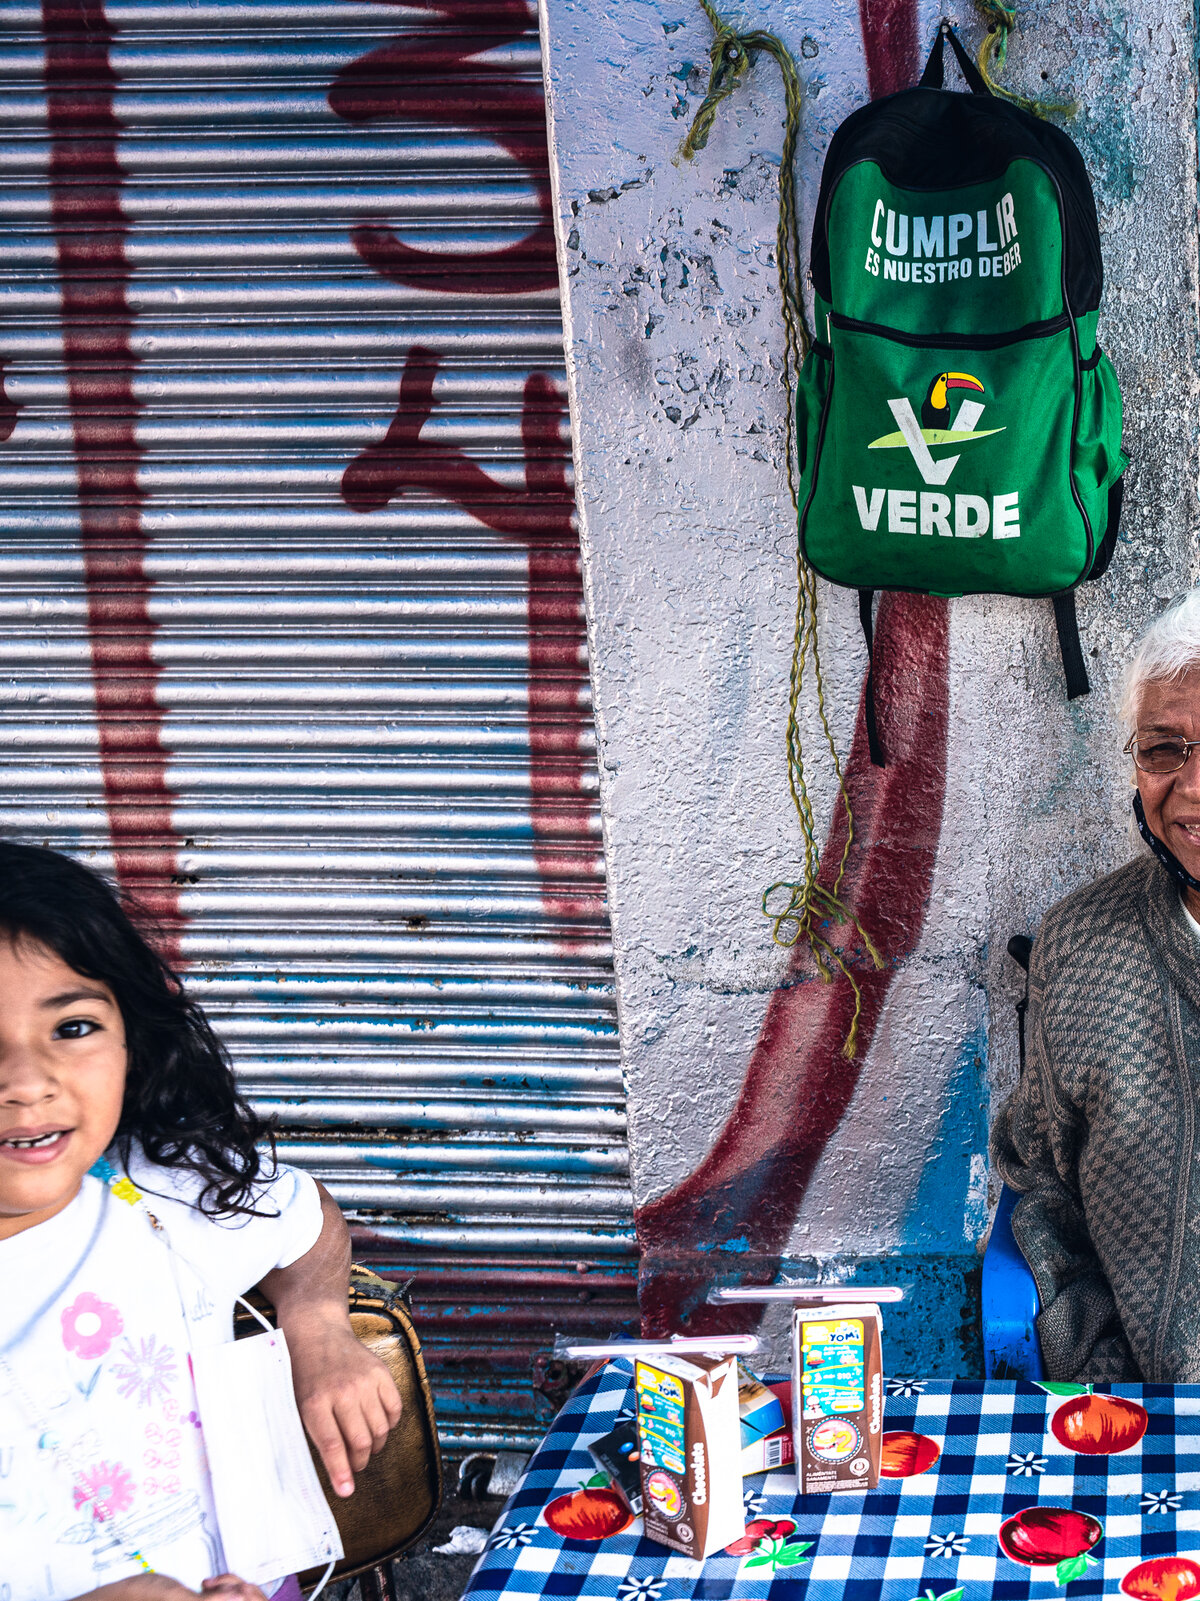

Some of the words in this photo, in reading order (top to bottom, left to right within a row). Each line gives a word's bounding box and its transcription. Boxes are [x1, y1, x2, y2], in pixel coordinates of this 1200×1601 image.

[870, 192, 1018, 258] CUMPLIR
[864, 247, 880, 277] ES
[883, 257, 971, 284] NUESTRO
[978, 241, 1022, 278] DEBER
[851, 485, 1021, 540] VERDE
[691, 1442, 707, 1505] Chocolate
